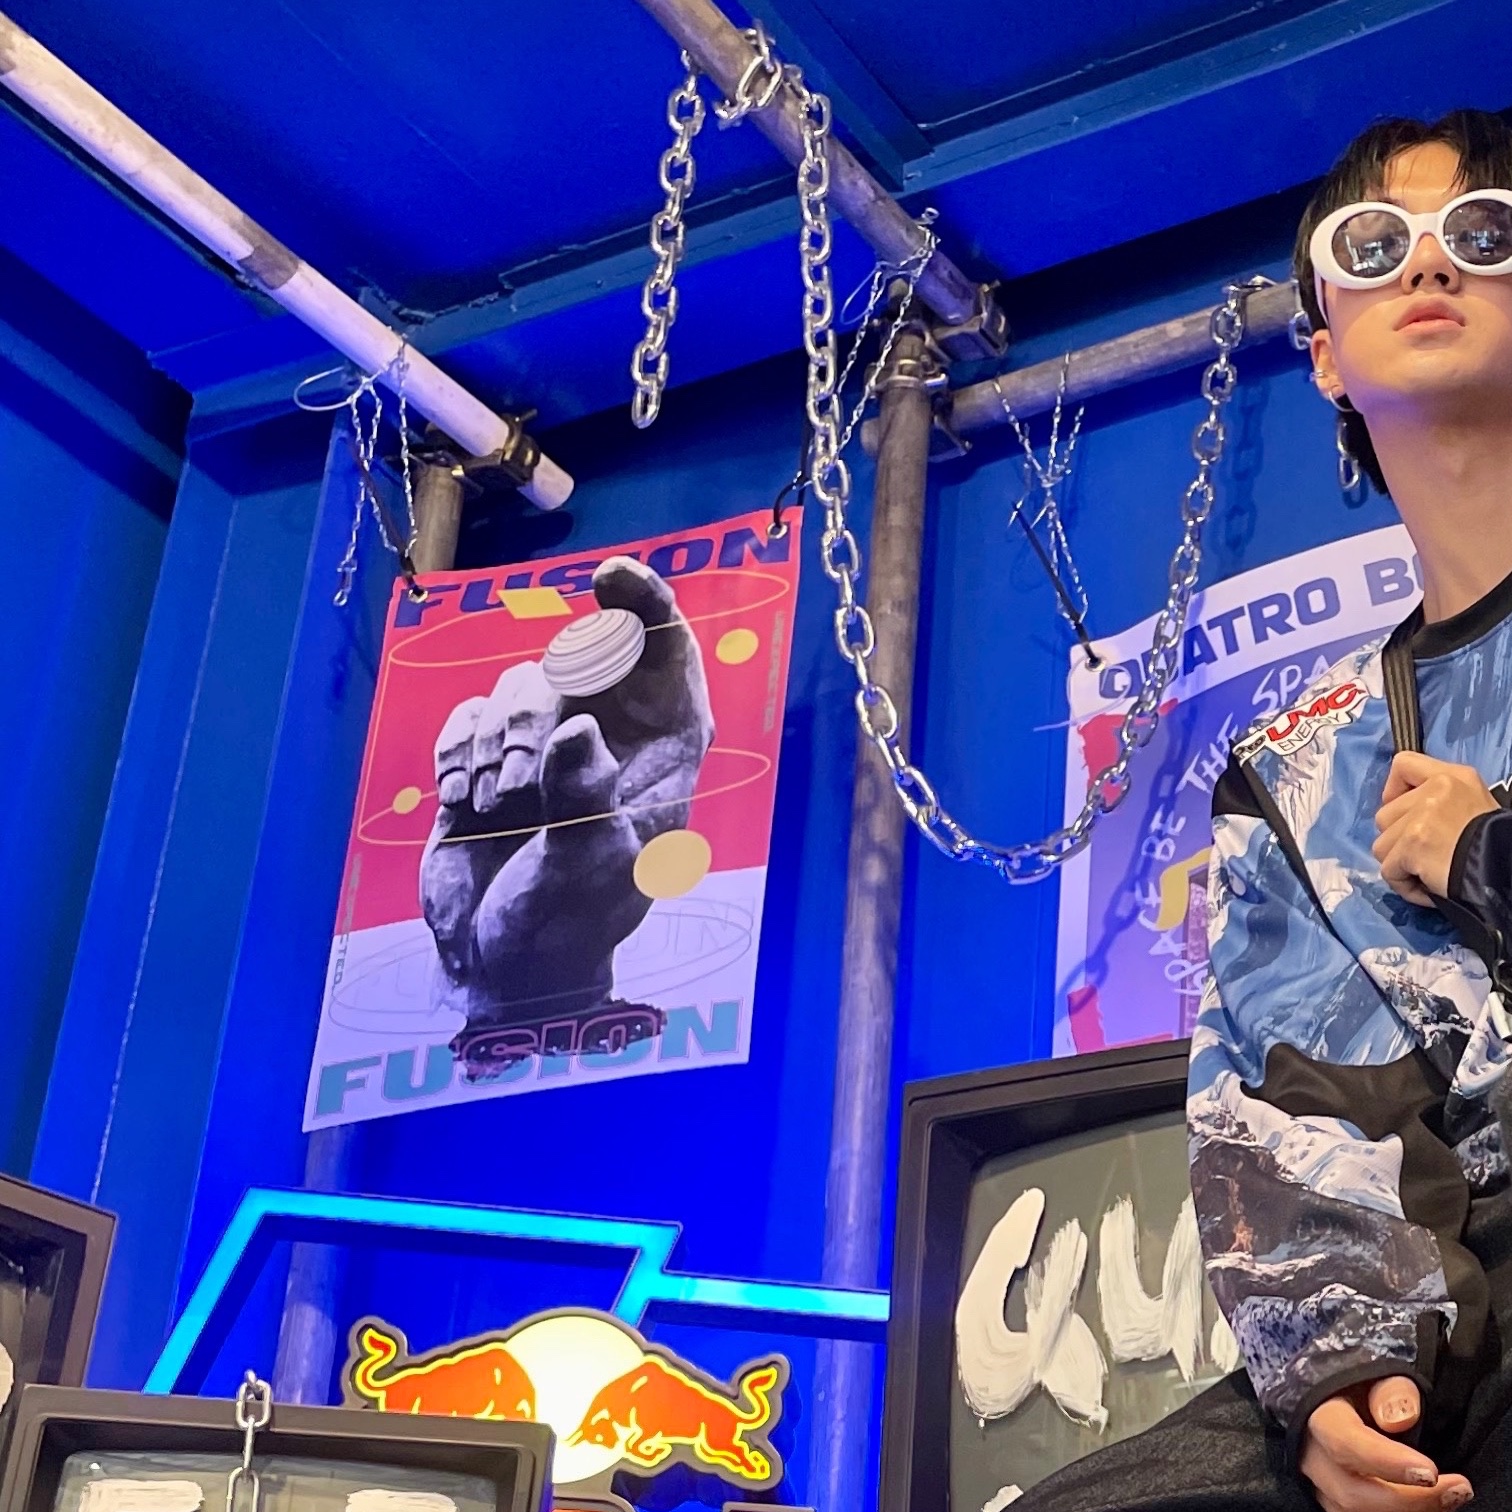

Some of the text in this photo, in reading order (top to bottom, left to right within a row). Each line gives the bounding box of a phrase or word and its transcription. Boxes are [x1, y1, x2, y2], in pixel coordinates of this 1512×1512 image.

[394, 521, 791, 628] FUSON
[1363, 555, 1424, 606] B
[312, 998, 744, 1119] FUSION
